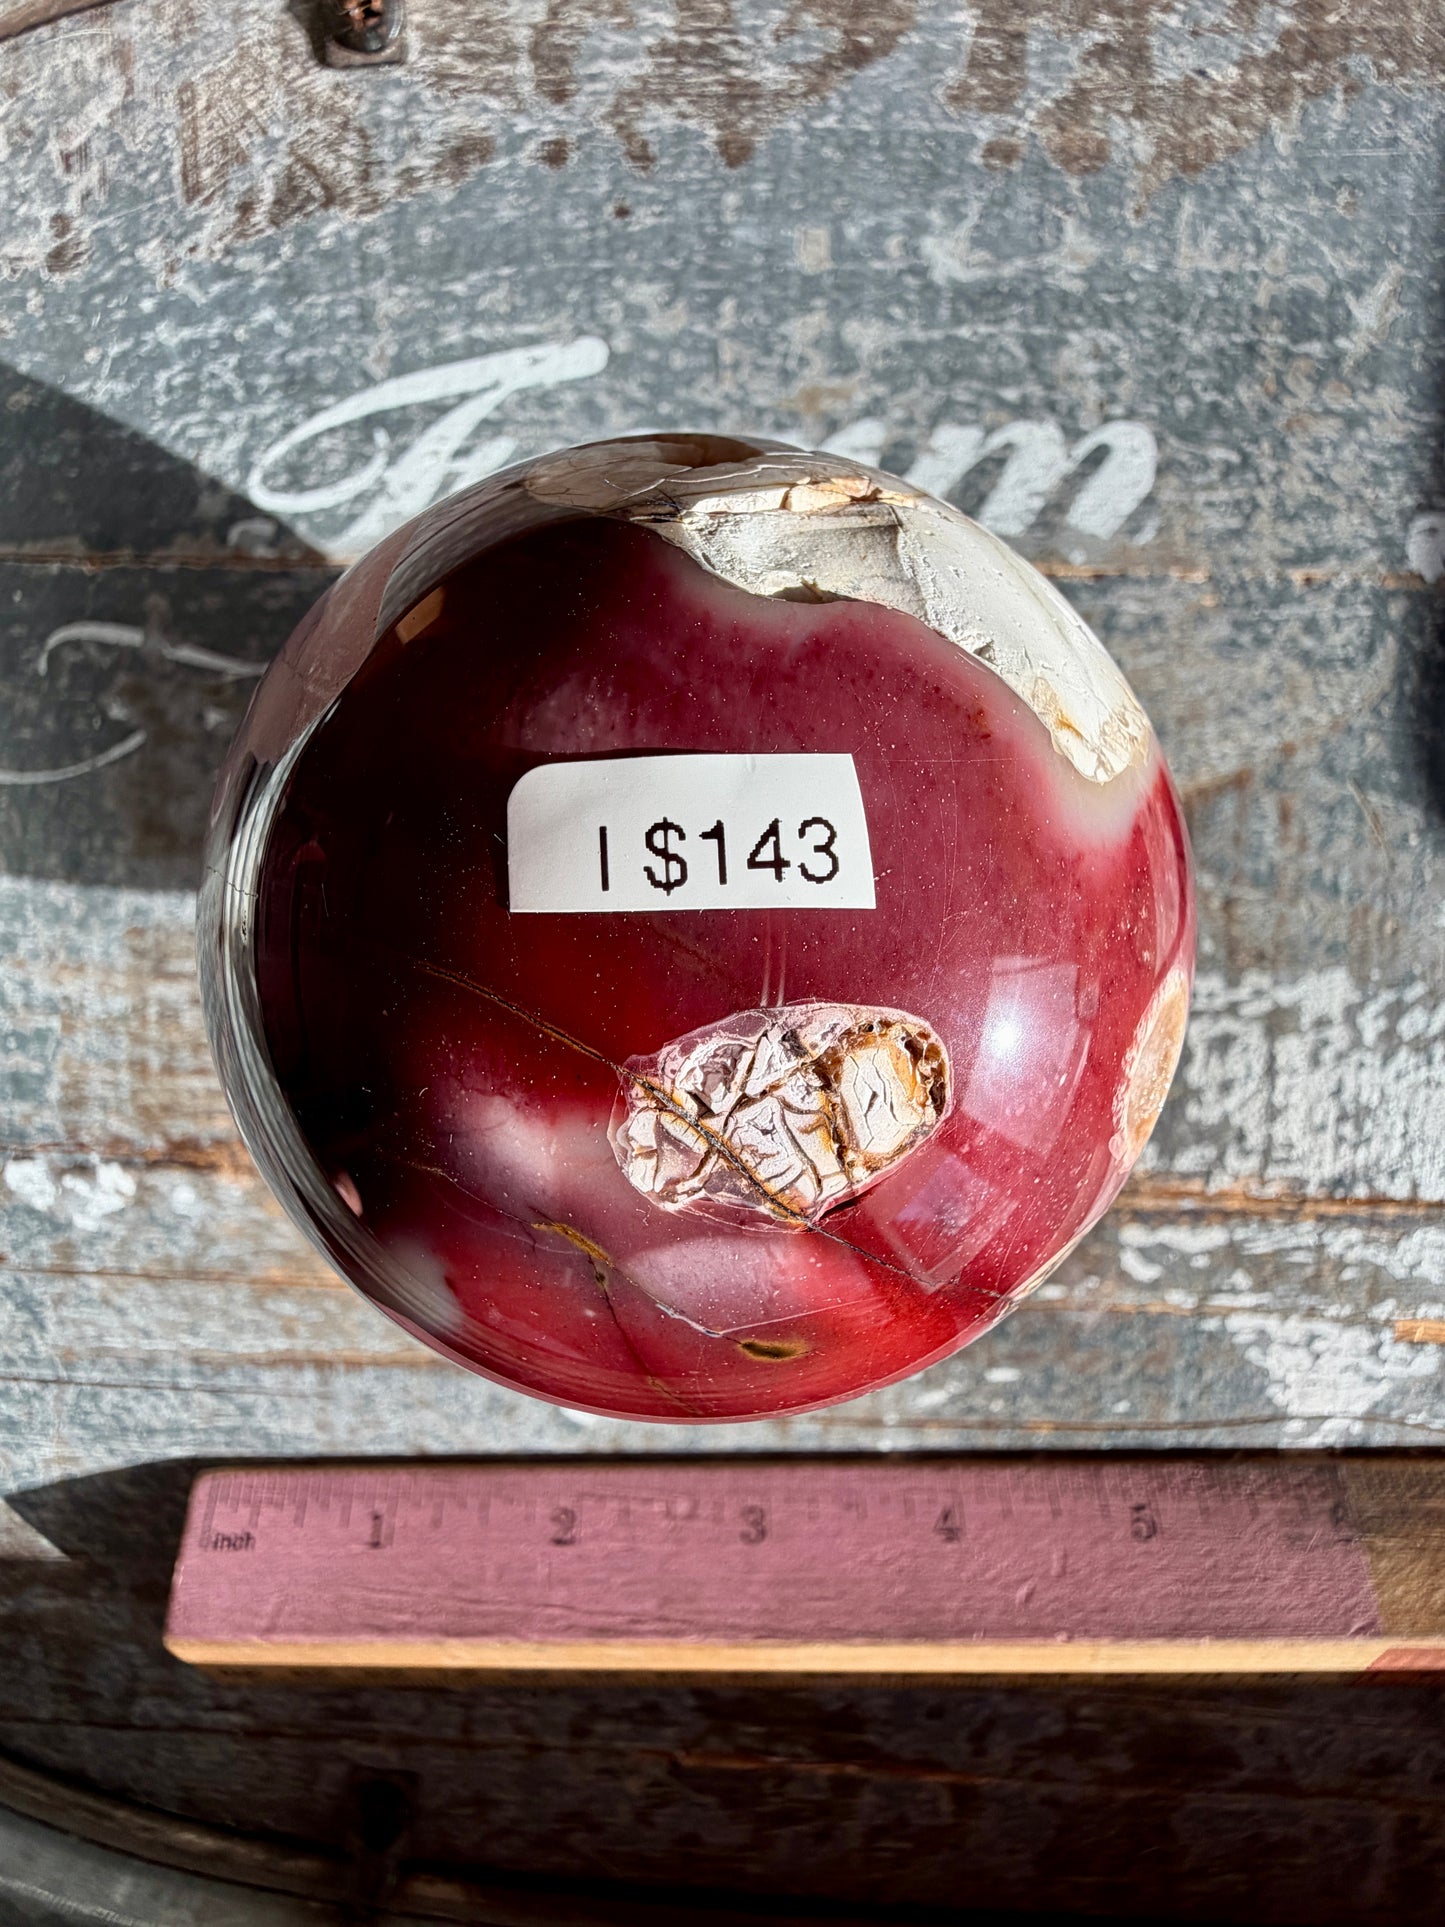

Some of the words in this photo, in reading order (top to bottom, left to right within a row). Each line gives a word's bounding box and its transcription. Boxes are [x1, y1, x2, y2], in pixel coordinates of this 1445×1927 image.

[643, 816, 841, 896] $143
[212, 1531, 256, 1551] inch
[369, 1509, 384, 1549] 1
[550, 1506, 577, 1546] 2
[740, 1504, 768, 1547] 3
[934, 1502, 963, 1542] 4
[1131, 1502, 1159, 1542] 5
